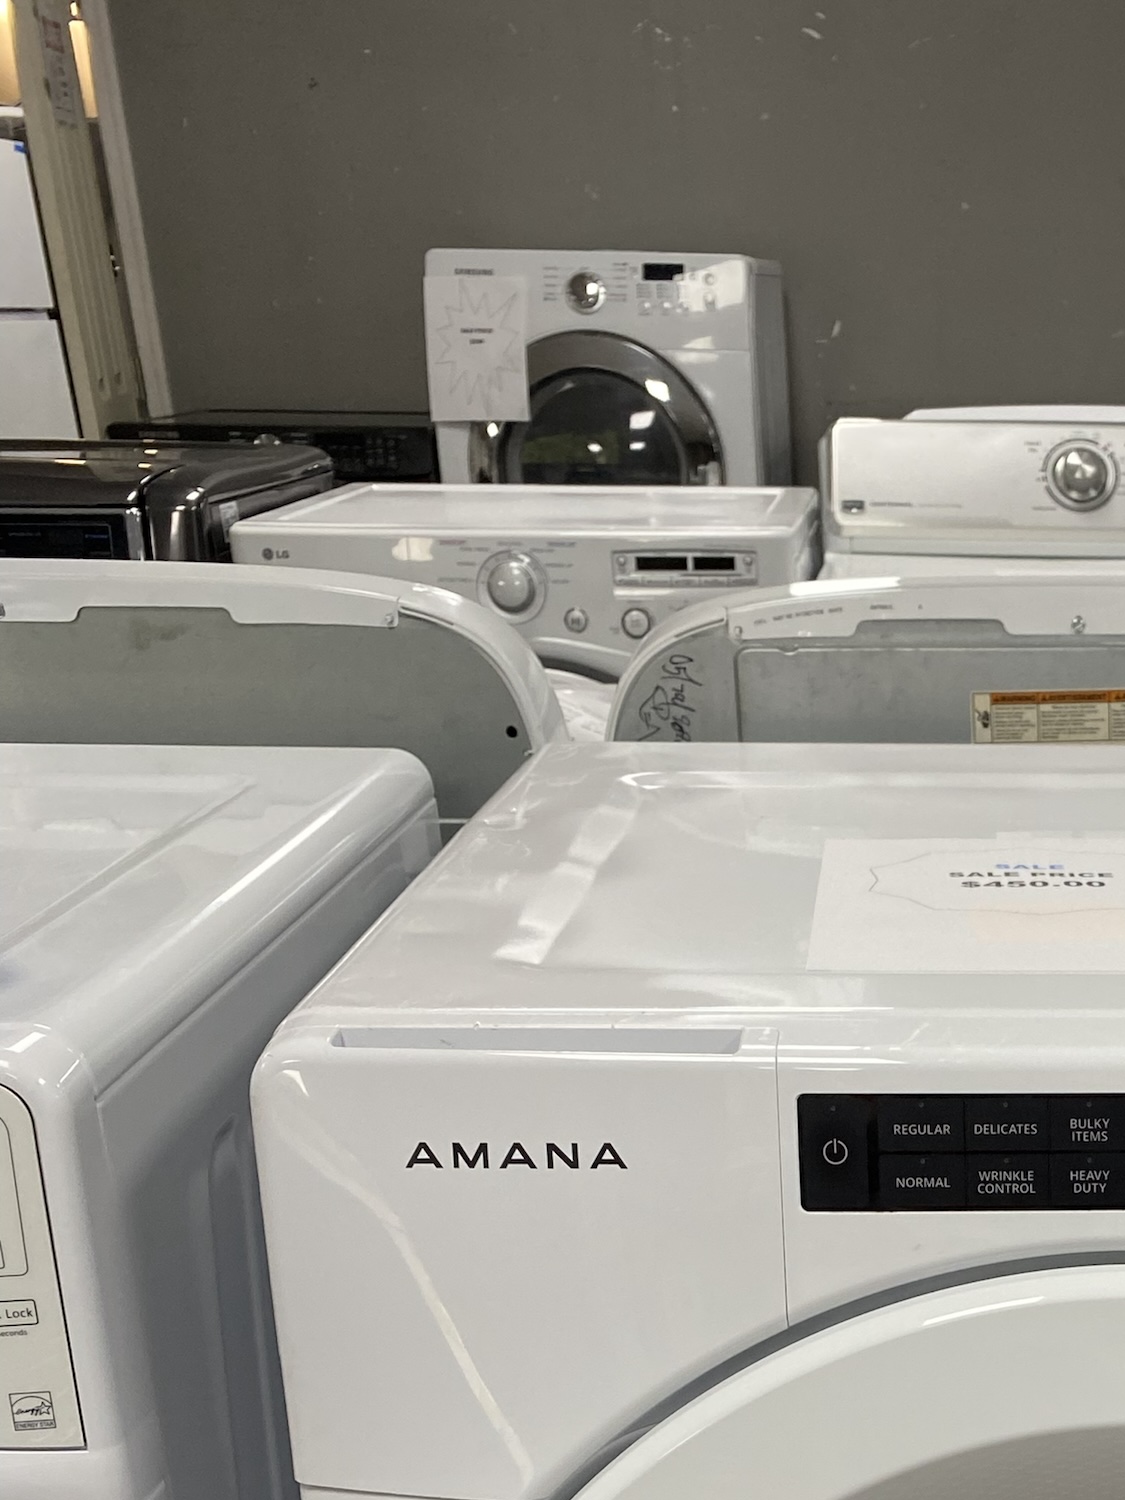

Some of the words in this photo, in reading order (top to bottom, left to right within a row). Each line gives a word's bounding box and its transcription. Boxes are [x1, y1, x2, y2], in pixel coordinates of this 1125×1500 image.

[893, 1124, 951, 1135] REGULAR
[973, 1123, 1038, 1135] DELICATES
[1069, 1118, 1111, 1130] BULKY
[1071, 1130, 1109, 1142] ITEMS
[405, 1141, 628, 1170] AMANA
[978, 1170, 1035, 1182] WRINKLE
[1069, 1170, 1111, 1181] HEAVY
[895, 1177, 951, 1188] NORMAL
[977, 1182, 1037, 1194] CONTROL
[1073, 1182, 1108, 1194] DUTY
[5, 1307, 34, 1319] Lock
[0, 1329, 28, 1337] econds
